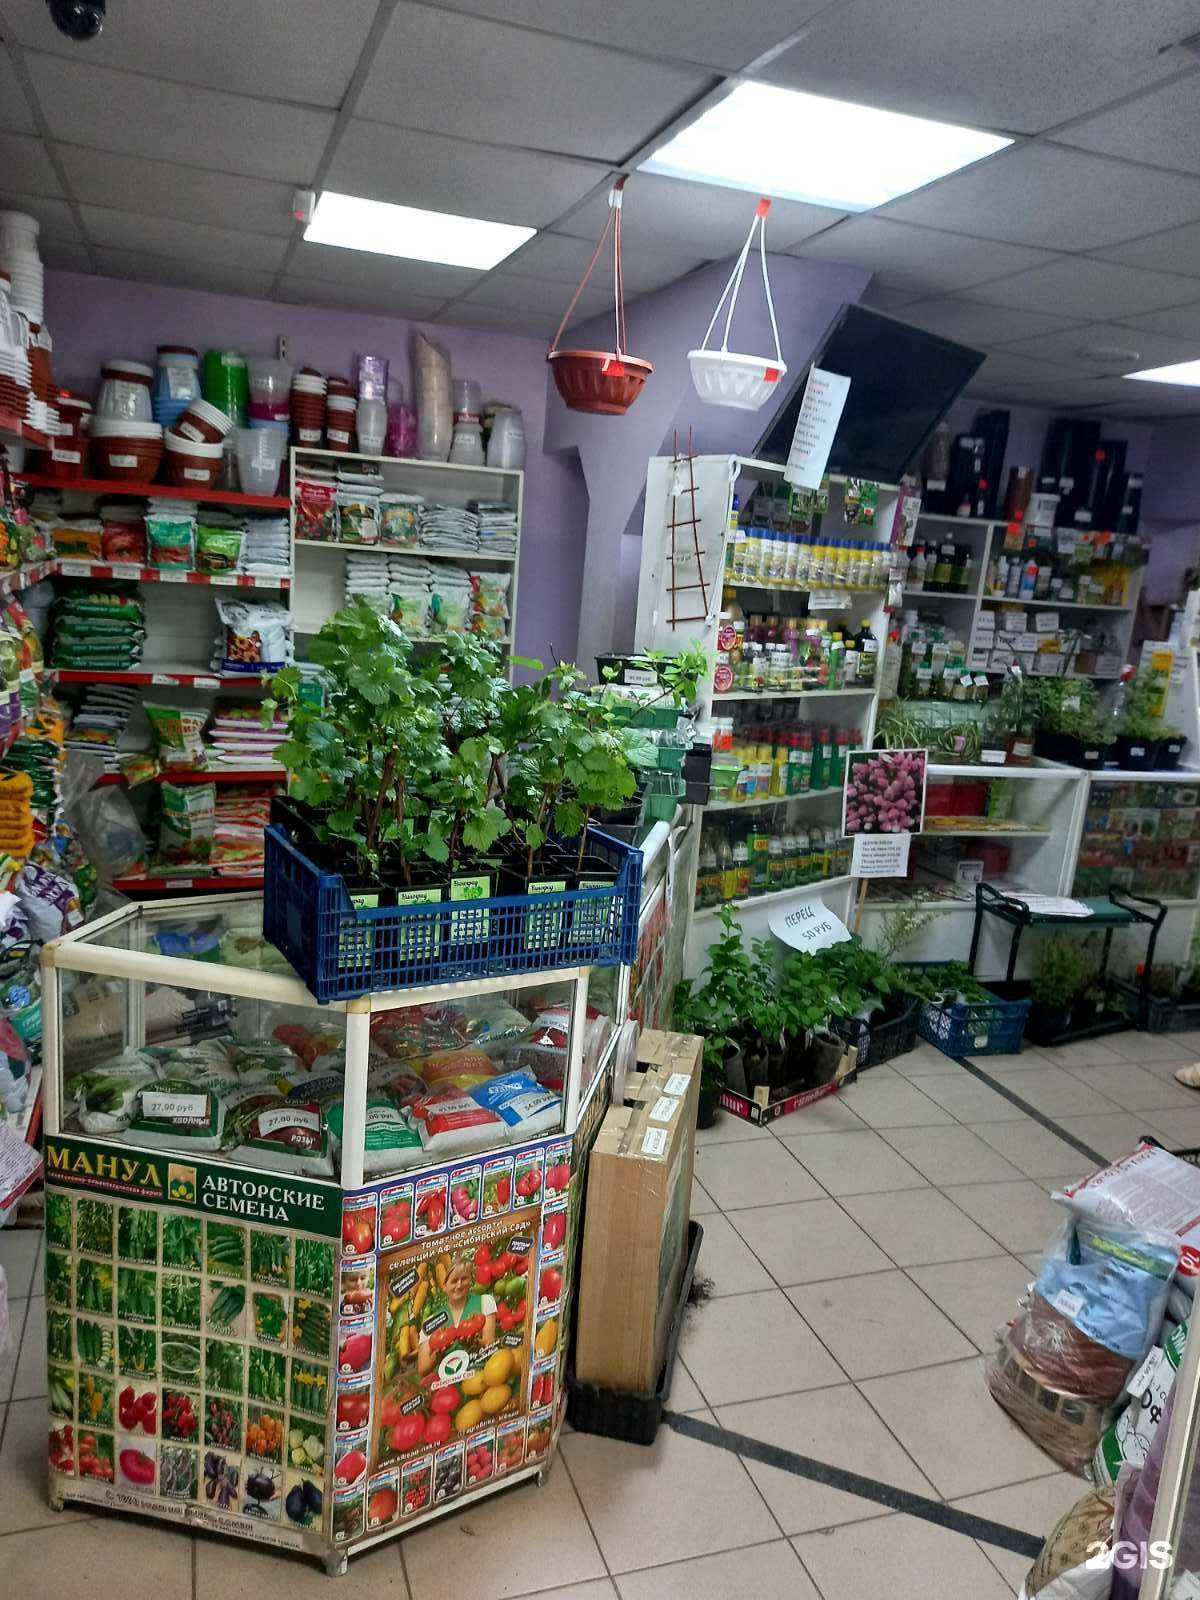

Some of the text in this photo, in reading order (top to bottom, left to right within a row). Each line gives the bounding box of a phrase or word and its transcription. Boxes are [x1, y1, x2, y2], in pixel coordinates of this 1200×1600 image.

[784, 905, 815, 928] ПЕРЕЦ
[801, 921, 832, 940] 50 РУБ
[47, 1146, 163, 1188] МАНУЛ
[202, 1175, 326, 1211] АВТОРСКИЕ
[202, 1193, 290, 1222] СЕМЕНА
[421, 1231, 467, 1250] Томатное
[388, 1250, 436, 1271] селекции
